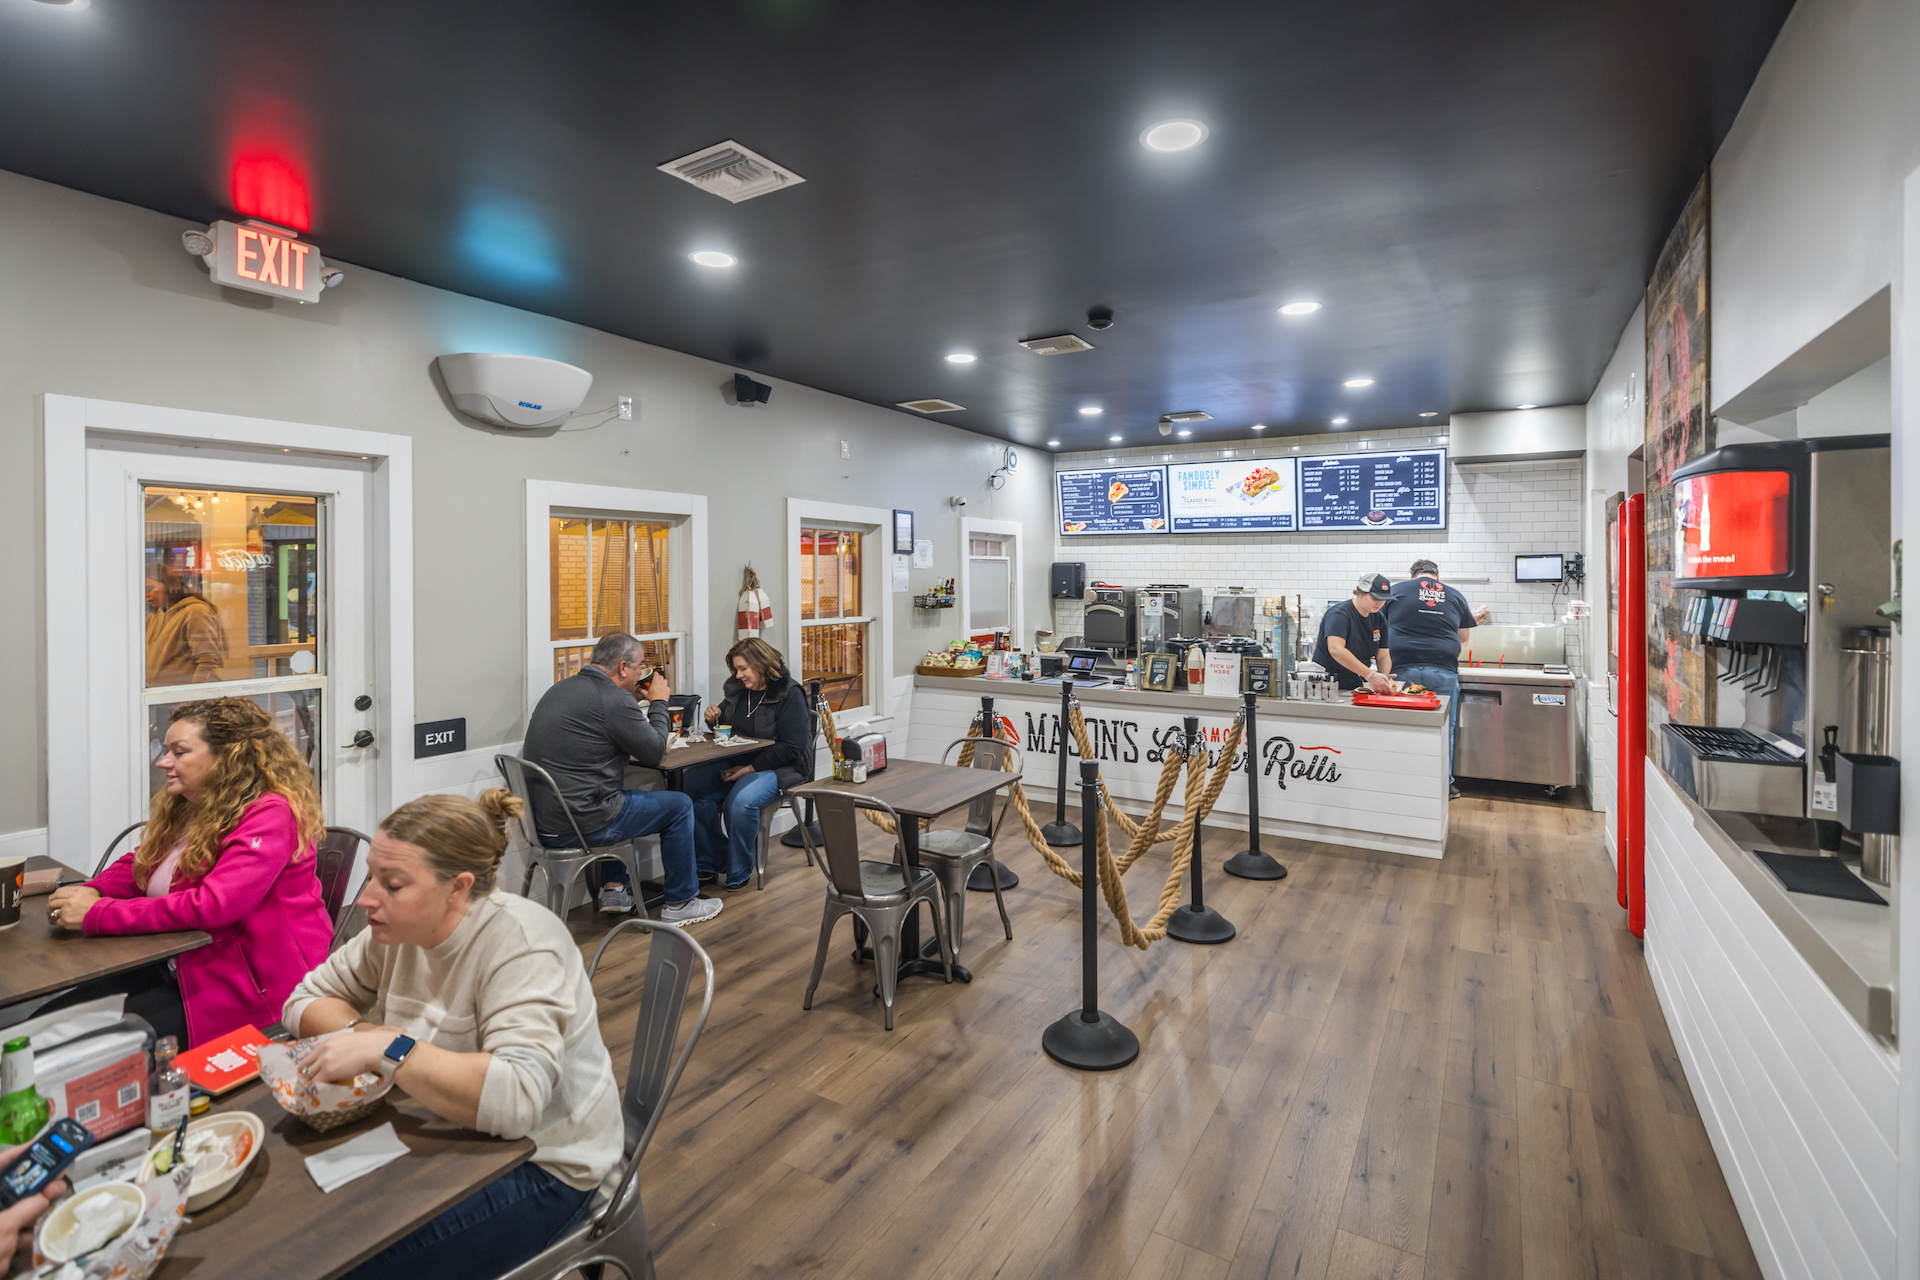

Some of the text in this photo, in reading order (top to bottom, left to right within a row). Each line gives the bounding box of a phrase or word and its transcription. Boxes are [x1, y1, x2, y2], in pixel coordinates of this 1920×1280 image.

[237, 227, 310, 291] EXIT
[518, 401, 542, 410] ECOLAB
[1178, 470, 1220, 481] FAMOUSLY
[1183, 481, 1215, 491] SIMPLE.
[1702, 555, 1712, 563] the
[1712, 554, 1735, 563] meal
[1419, 589, 1445, 598] MASON'S
[425, 730, 456, 746] EXIT
[1025, 711, 1139, 763] MASON'S
[1263, 735, 1342, 790] Rolls
